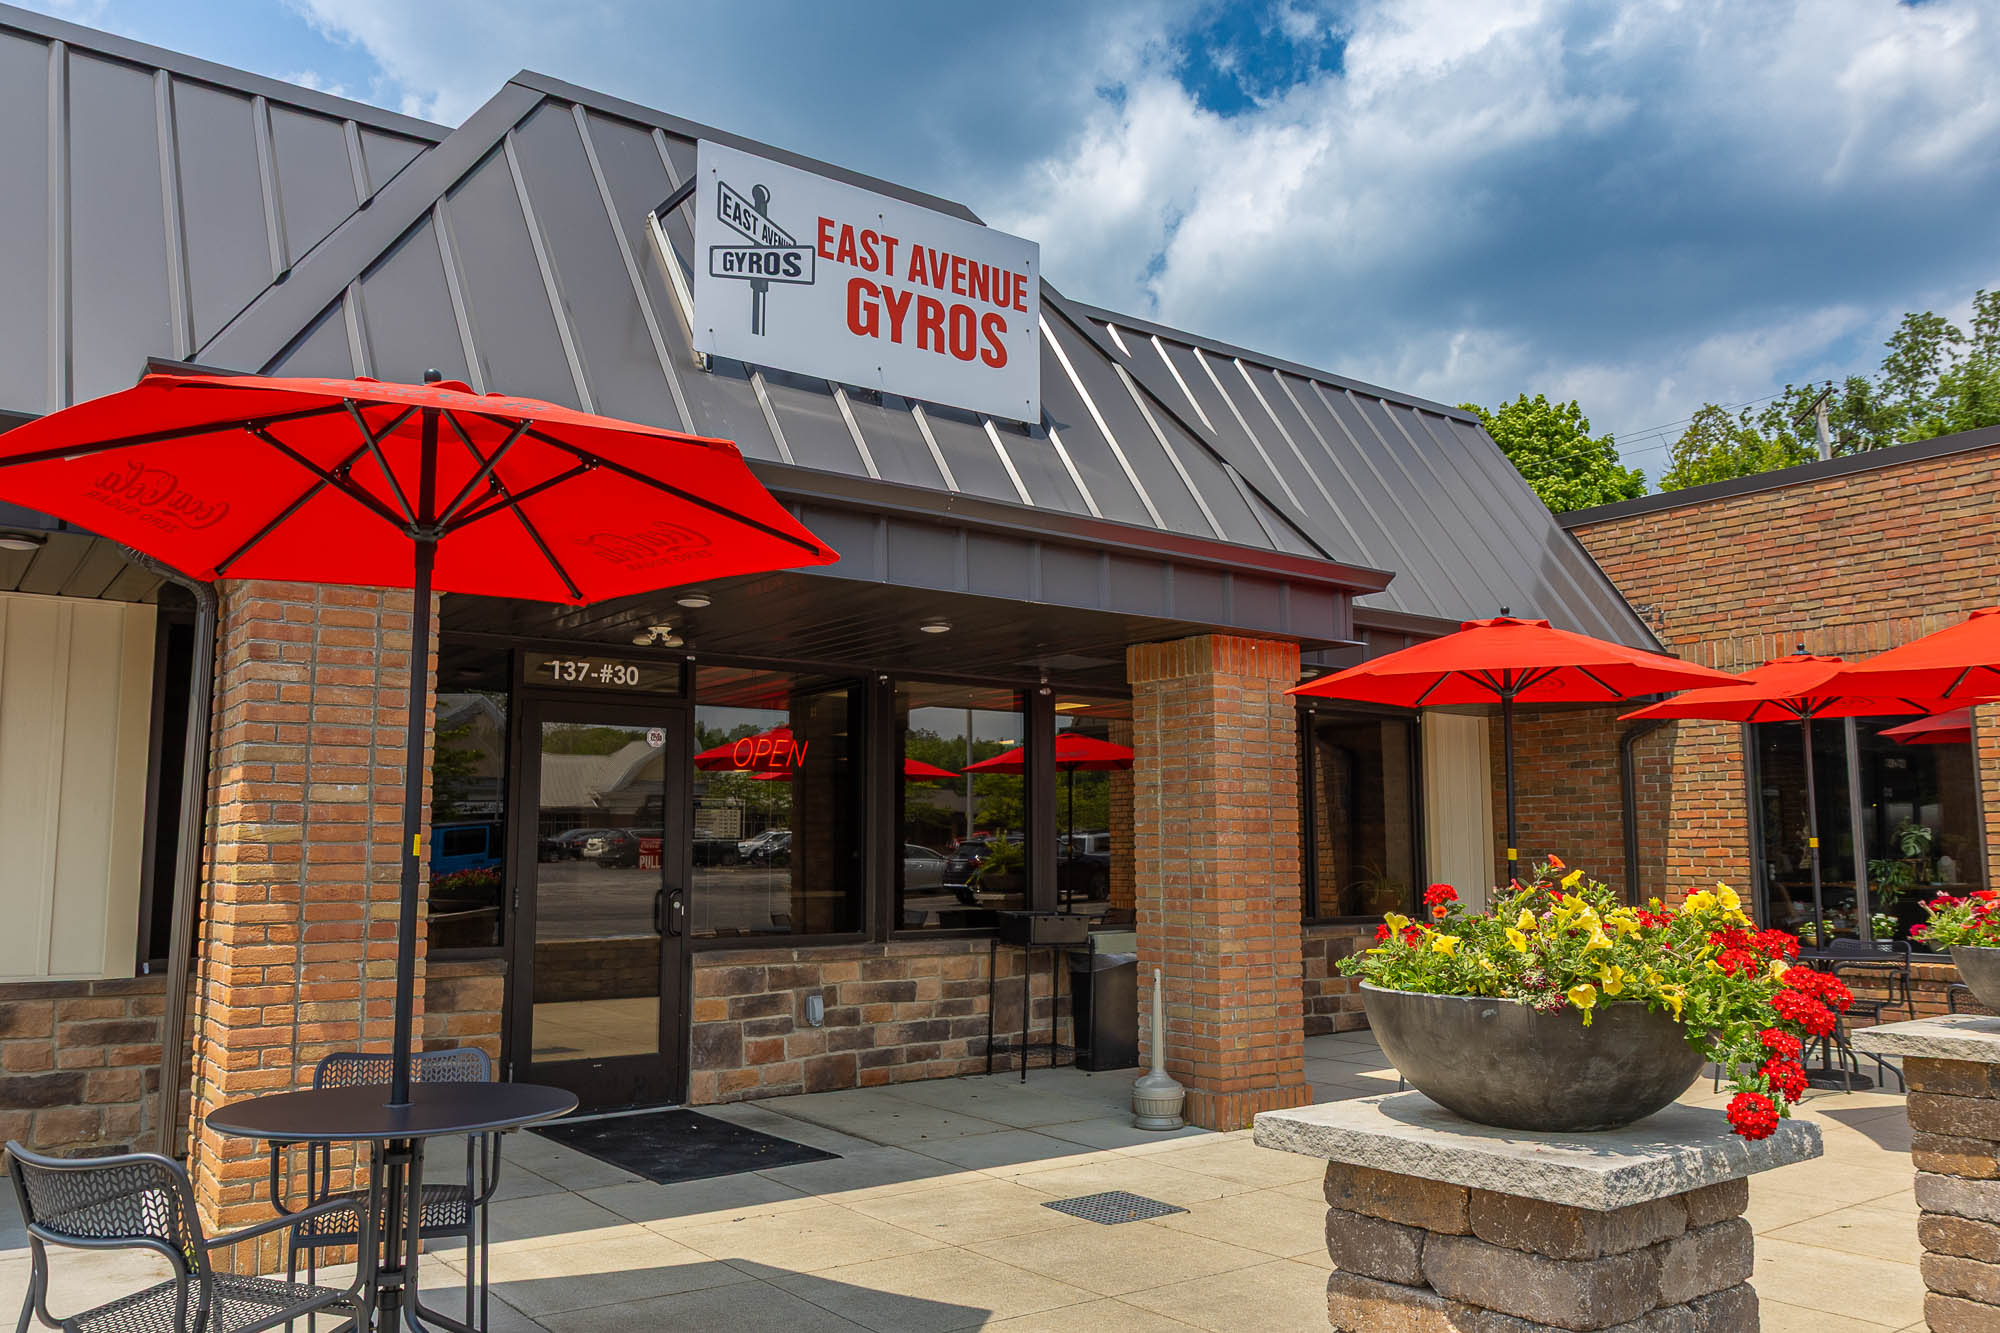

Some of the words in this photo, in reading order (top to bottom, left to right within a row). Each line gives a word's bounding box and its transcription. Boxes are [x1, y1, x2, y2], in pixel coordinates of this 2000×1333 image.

[723, 191, 759, 236] EAST
[761, 223, 793, 247] AVEN
[722, 251, 802, 278] GYROS
[817, 216, 899, 276] EAST
[908, 244, 1028, 313] AVENUE
[847, 277, 1008, 369] GYROS
[551, 660, 639, 686] 137-#30
[733, 737, 809, 768] OPEN
[640, 855, 662, 870] PULL
